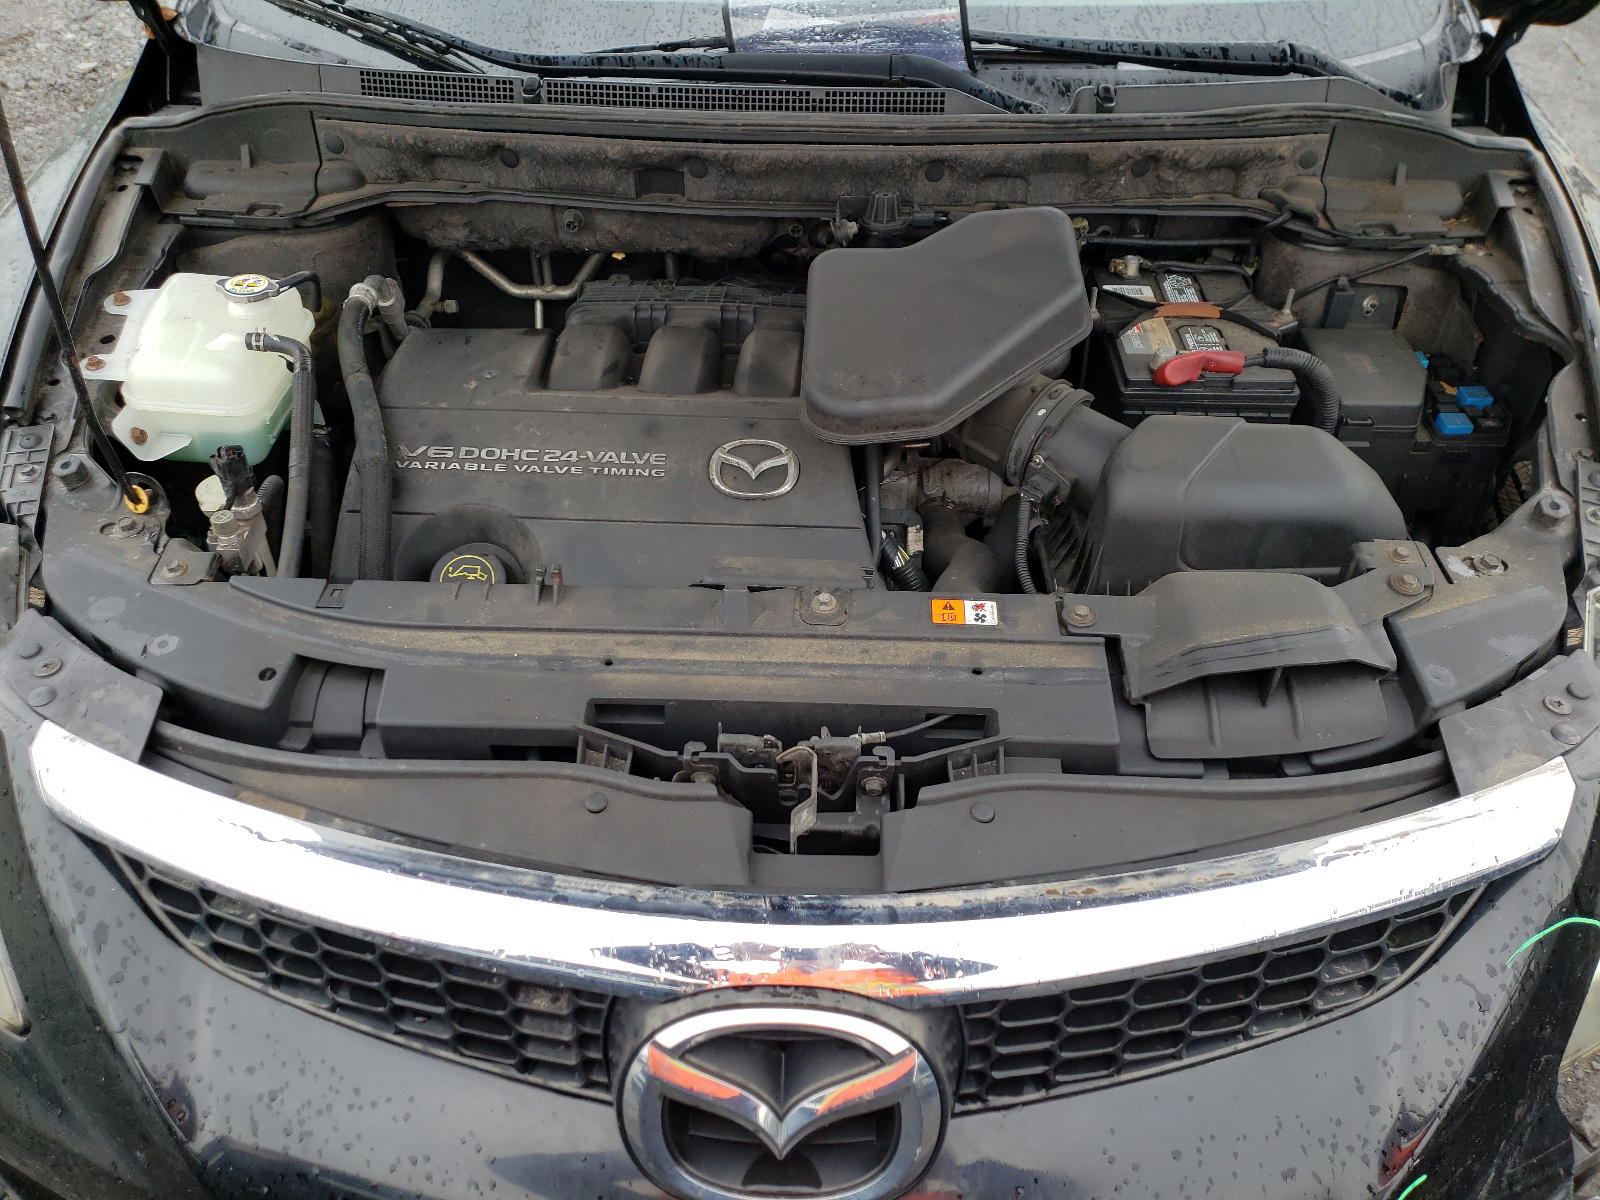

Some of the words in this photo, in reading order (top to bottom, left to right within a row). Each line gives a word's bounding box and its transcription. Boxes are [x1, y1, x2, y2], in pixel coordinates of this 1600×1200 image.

[399, 444, 454, 459] V6
[459, 446, 540, 461] DOHC
[543, 449, 667, 466] 24-VALVE
[395, 460, 508, 472] VARIABLE
[513, 464, 584, 475] VALVE
[588, 467, 666, 478] TIMING
